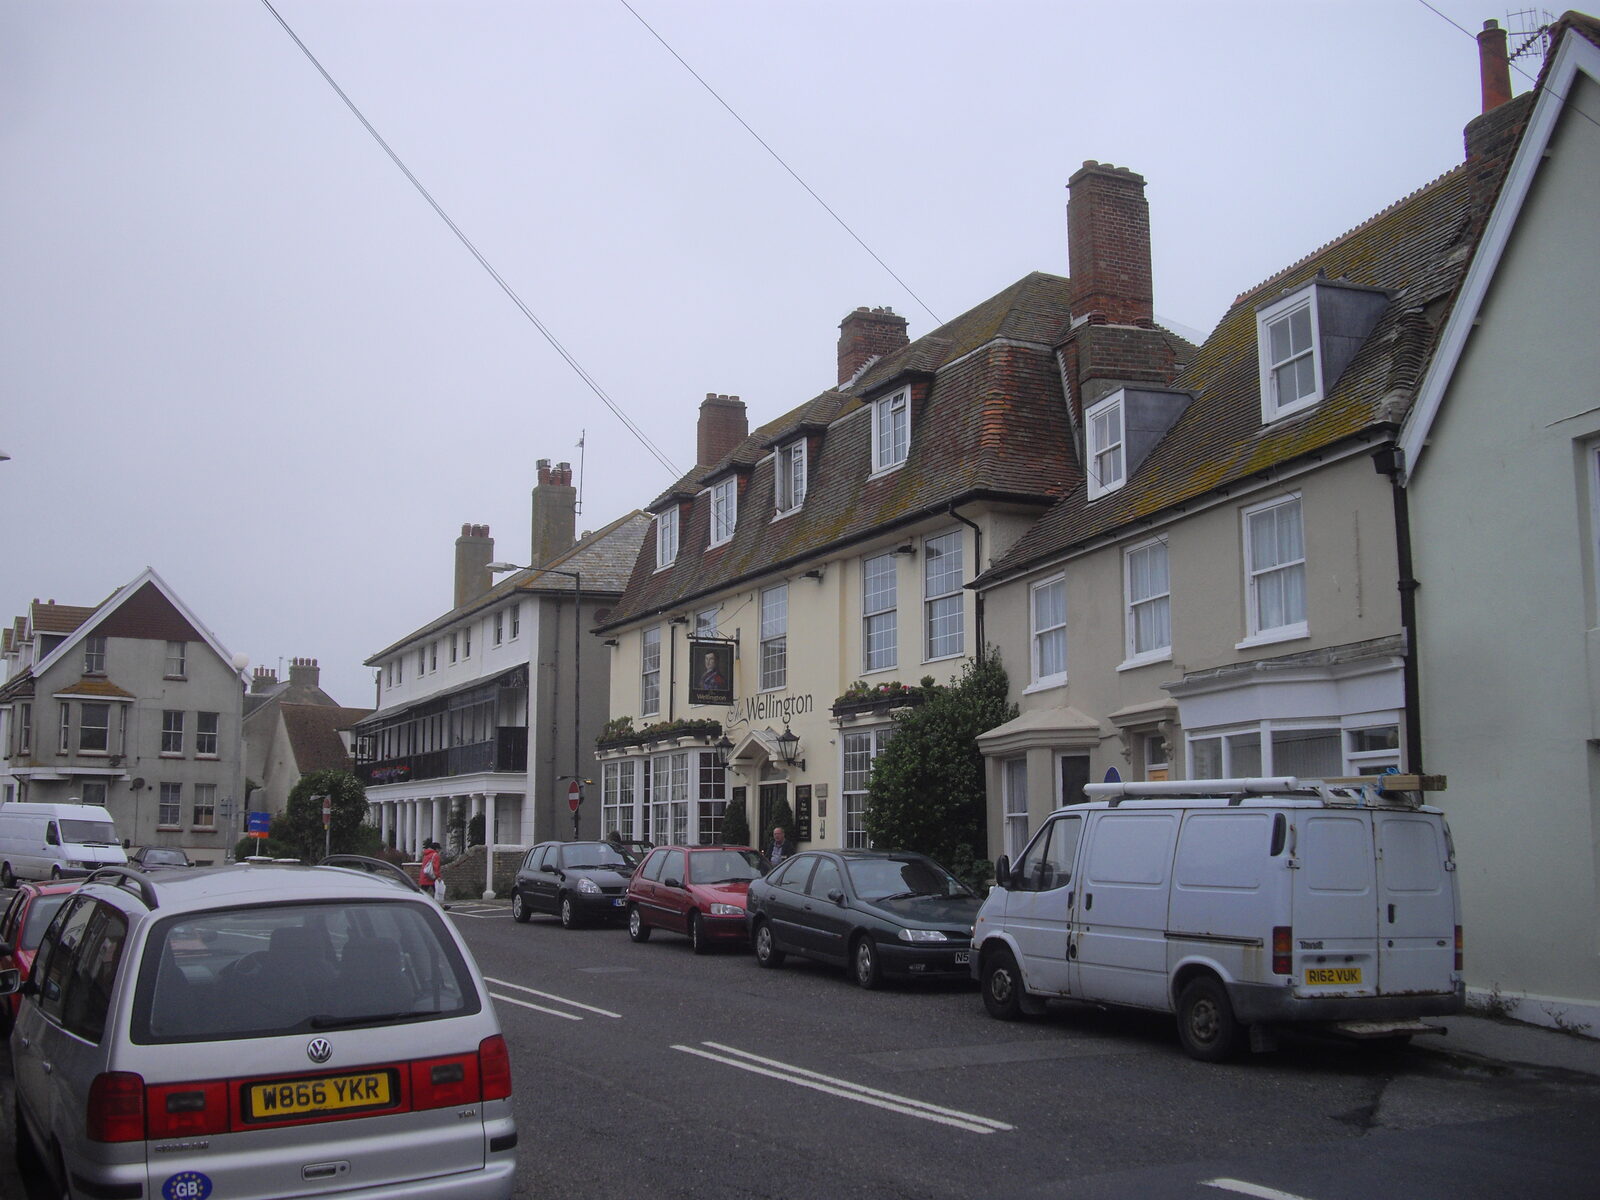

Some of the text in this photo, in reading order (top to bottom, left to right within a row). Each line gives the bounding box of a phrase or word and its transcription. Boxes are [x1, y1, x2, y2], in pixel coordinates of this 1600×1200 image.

[746, 693, 813, 725] Wellington
[1309, 968, 1358, 983] R162 VUK
[262, 1076, 380, 1111] W866 YKR
[175, 1181, 198, 1198] GB
